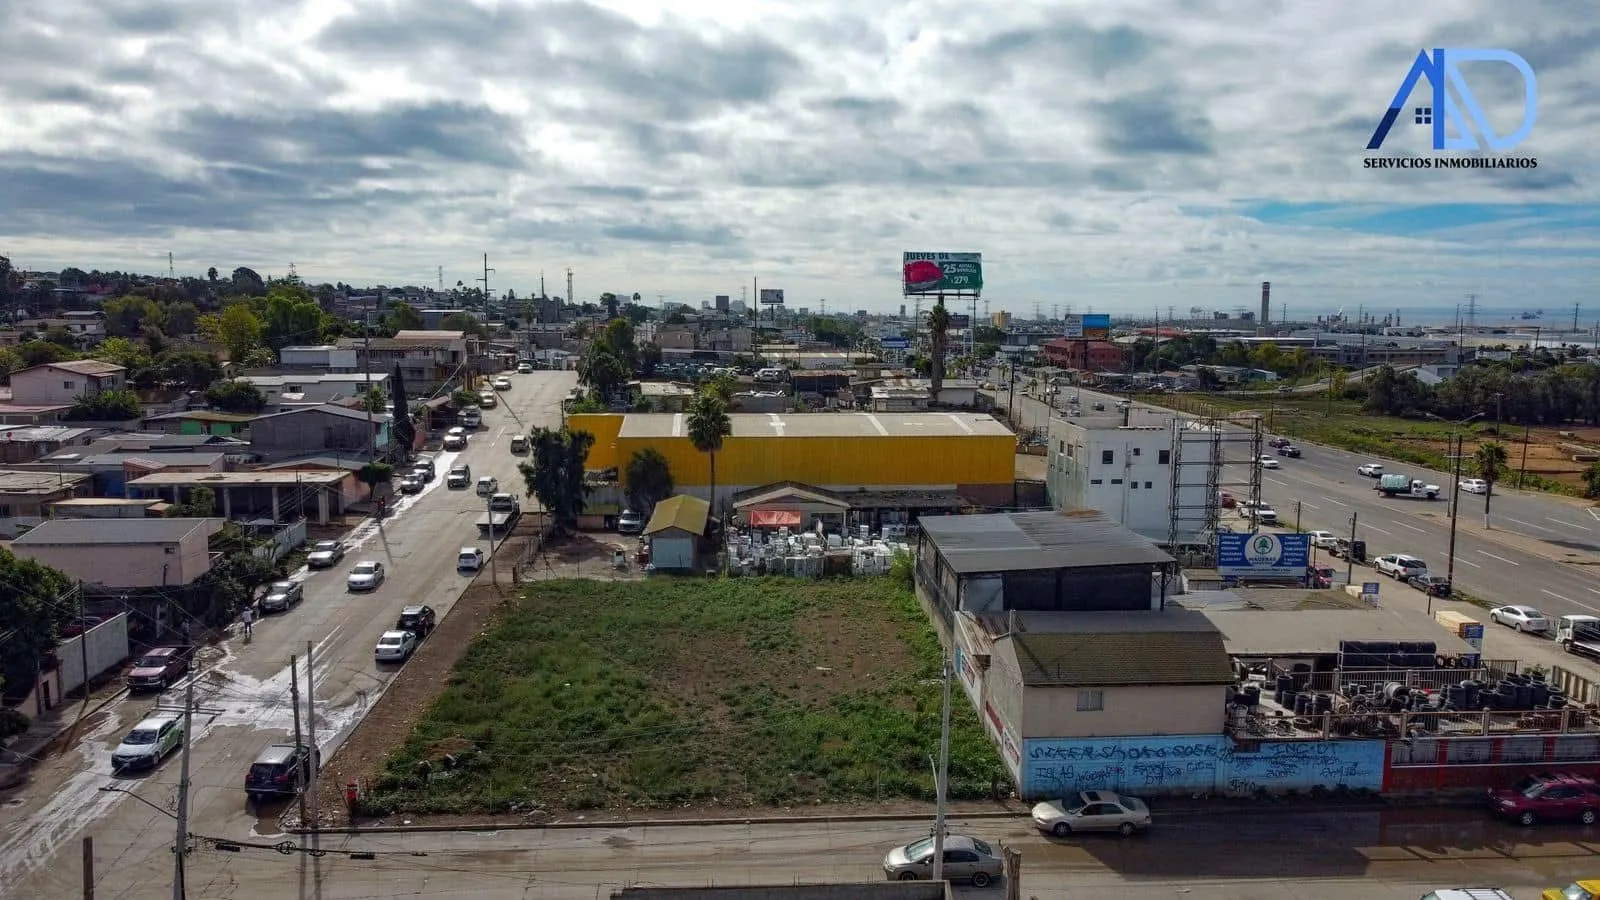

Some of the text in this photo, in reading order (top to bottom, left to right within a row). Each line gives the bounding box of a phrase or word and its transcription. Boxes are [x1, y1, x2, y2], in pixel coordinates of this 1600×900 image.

[905, 252, 950, 260] JUEVES DE
[943, 264, 957, 274] 25
